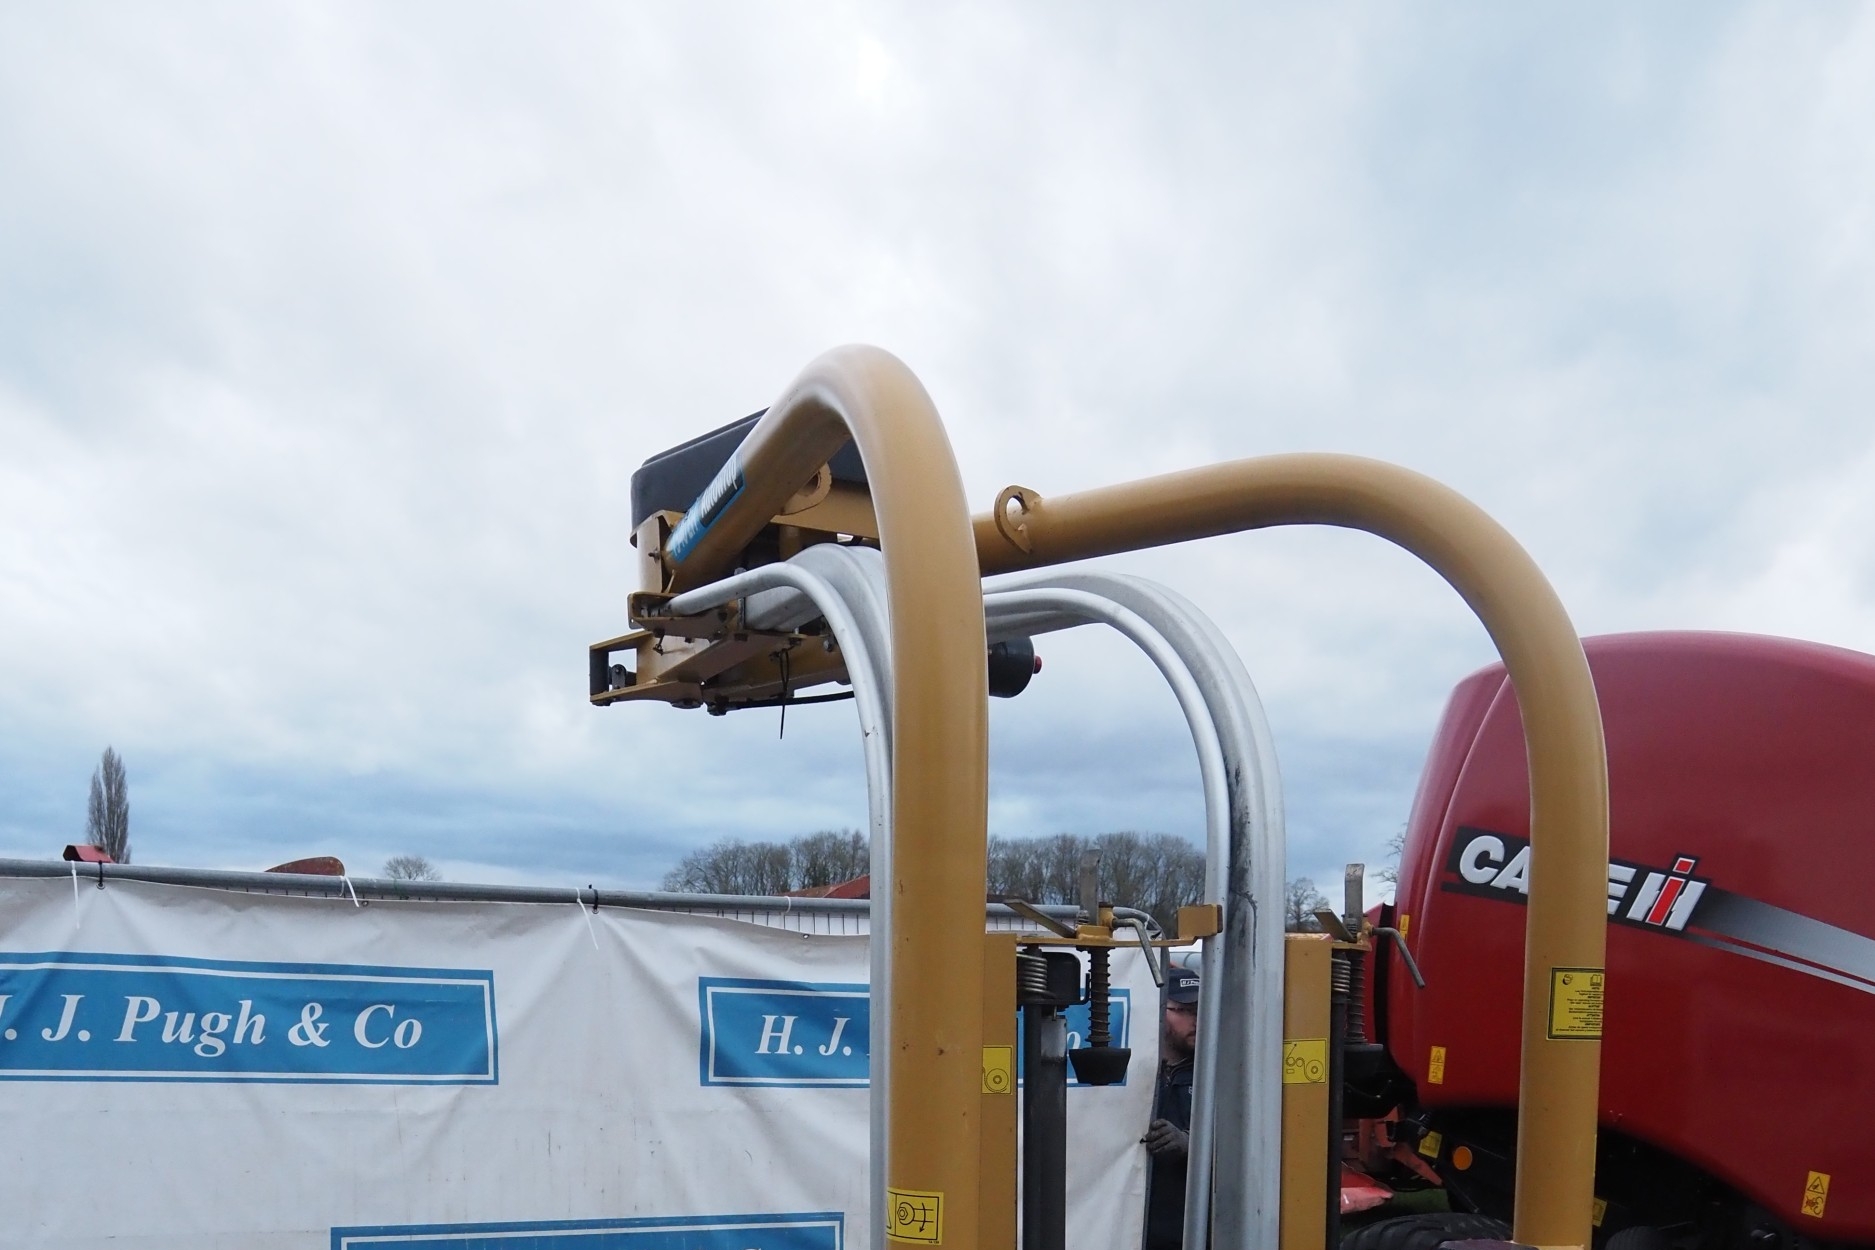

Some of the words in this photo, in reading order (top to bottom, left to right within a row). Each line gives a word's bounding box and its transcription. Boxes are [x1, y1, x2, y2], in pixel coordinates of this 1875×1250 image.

[1459, 835, 1637, 915] CAE
[42, 994, 91, 1042] J.
[113, 995, 266, 1058] Pugh
[287, 1002, 331, 1048] &
[353, 1004, 423, 1049] Co
[754, 1014, 804, 1056] H.
[818, 1017, 852, 1057] J.
